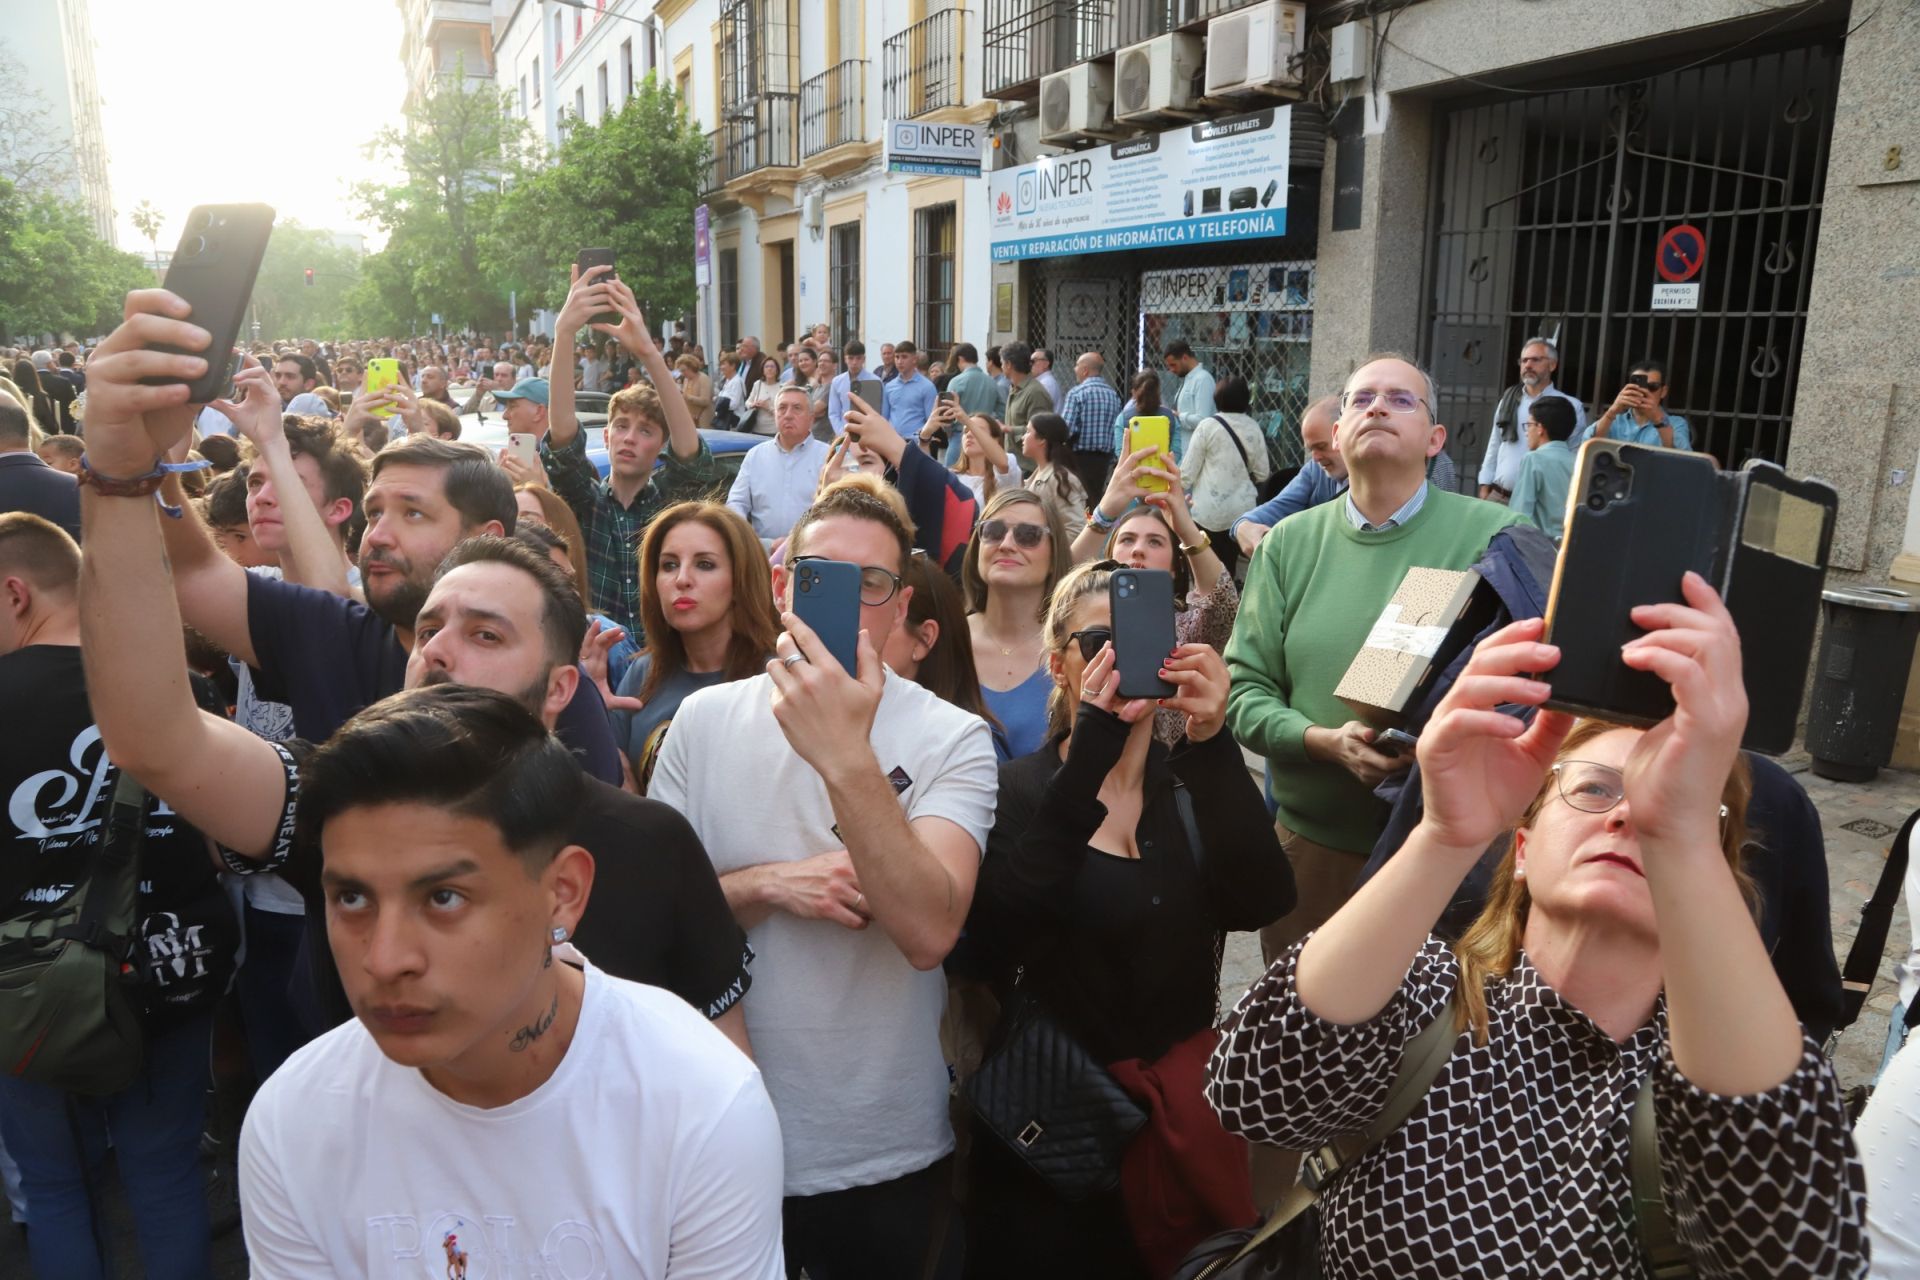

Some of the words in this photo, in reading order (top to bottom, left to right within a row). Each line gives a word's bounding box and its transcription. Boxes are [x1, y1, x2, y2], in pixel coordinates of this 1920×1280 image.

[921, 126, 976, 148] INPER
[1201, 125, 1228, 139] MÓVILES
[1234, 118, 1260, 132] TABLETS
[1117, 142, 1152, 157] INFORMÁTICA
[1883, 144, 1902, 171] 8
[1039, 158, 1092, 200] INPER
[993, 244, 1020, 259] VENTA
[1021, 243, 1027, 256] Y
[1029, 234, 1087, 255] REPARACIÓN
[1090, 235, 1103, 249] DE
[1105, 225, 1185, 247] INFORMÁTICA
[1188, 223, 1196, 239] Y
[1200, 212, 1276, 238] TELEFONÍA
[1163, 273, 1208, 299] INPER
[1661, 287, 1692, 295] PERMISO
[709, 976, 743, 1018] AWAY
